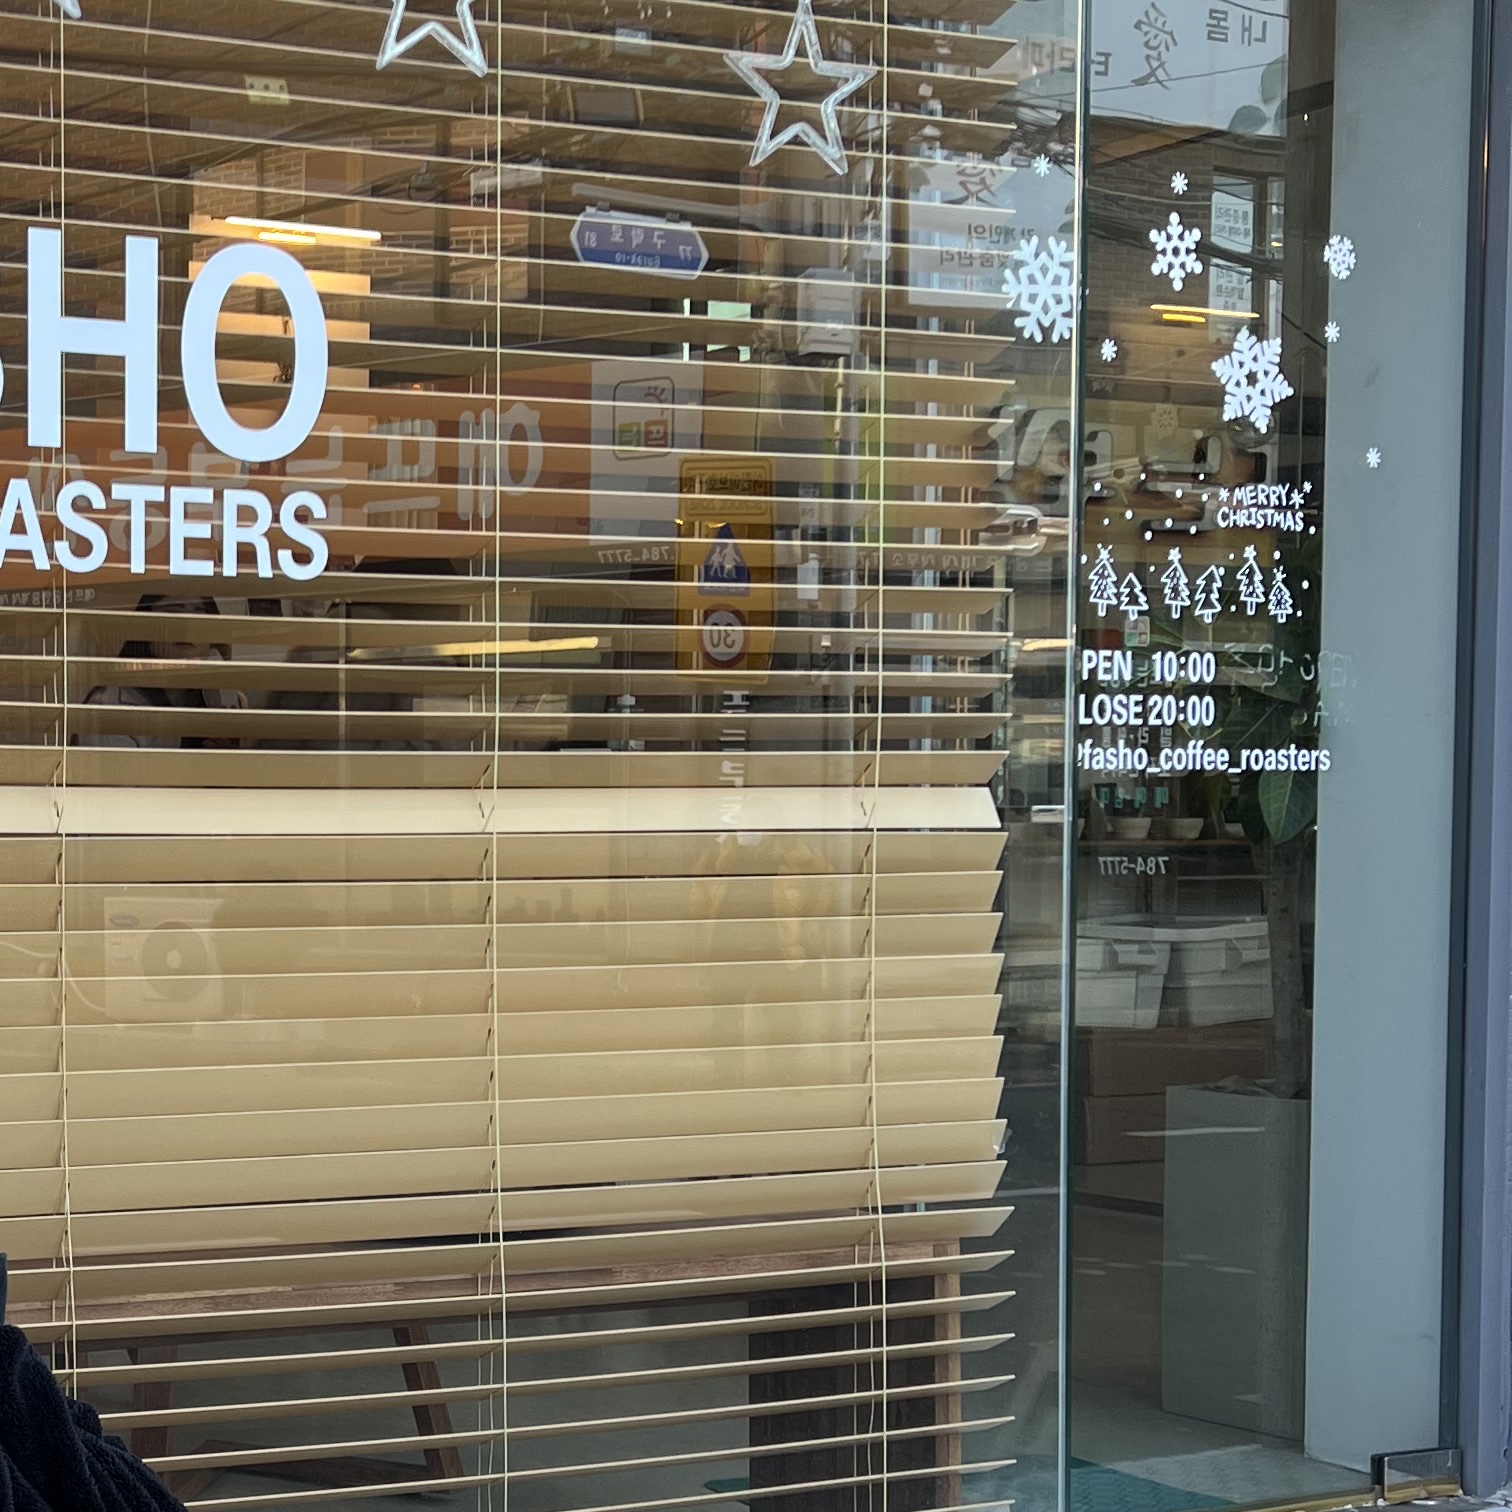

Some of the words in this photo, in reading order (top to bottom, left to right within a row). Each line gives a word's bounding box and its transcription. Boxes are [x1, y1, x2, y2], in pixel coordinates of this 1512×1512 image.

[1232, 484, 1290, 506] MERRY
[1216, 507, 1304, 531] CHRISTMAS
[1081, 649, 1133, 682] PEN
[1151, 650, 1216, 684] 10:00
[1078, 694, 1143, 727] LOSE
[1148, 695, 1215, 727] 20:00
